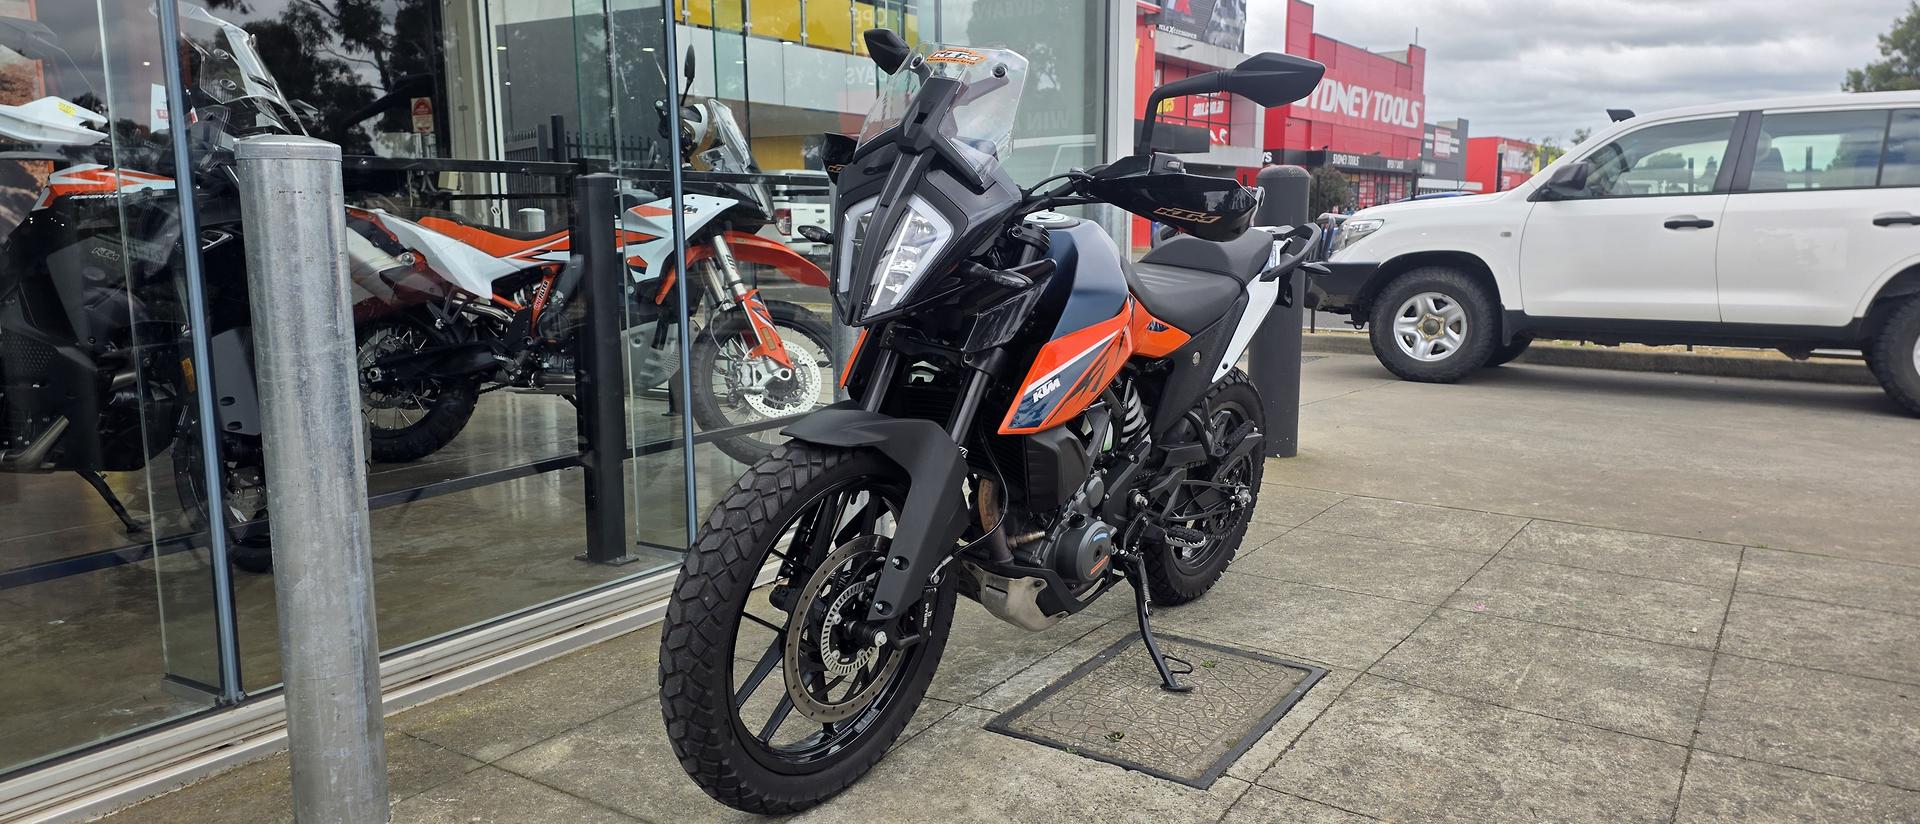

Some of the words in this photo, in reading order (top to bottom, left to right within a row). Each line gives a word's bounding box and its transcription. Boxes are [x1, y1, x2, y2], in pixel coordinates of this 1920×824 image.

[1373, 91, 1420, 129] TOOLS
[1332, 153, 1347, 165] SYDNEY
[1348, 155, 1360, 166] TOOLS
[1153, 207, 1222, 224] KTM
[1032, 377, 1061, 403] KTM
